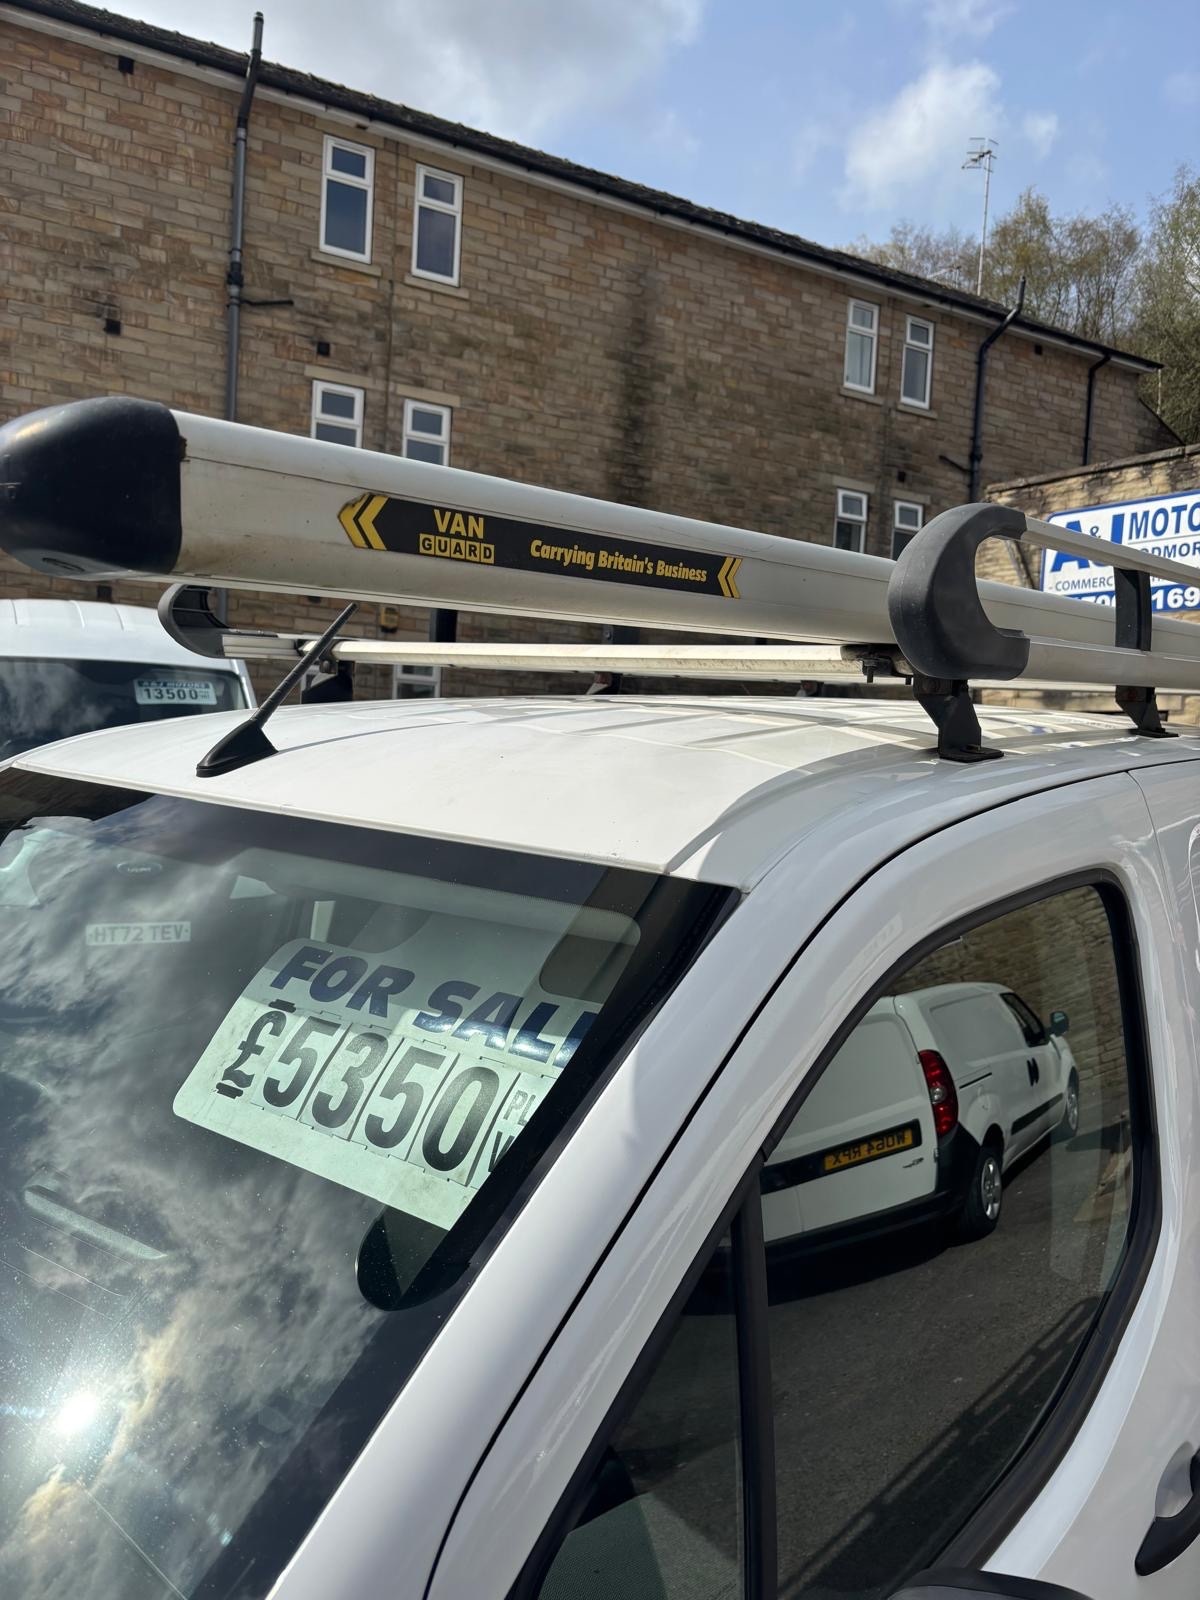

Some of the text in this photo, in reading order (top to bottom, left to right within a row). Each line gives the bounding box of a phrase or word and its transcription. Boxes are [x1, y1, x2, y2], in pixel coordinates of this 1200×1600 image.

[433, 508, 484, 539] VAN
[1128, 502, 1200, 540] MOTO
[420, 535, 494, 562] GUARD
[530, 539, 708, 583] Carrying Britain's Business
[143, 688, 199, 700] 13500
[93, 923, 184, 942] HT72 TEV
[270, 945, 415, 1018] FOR
[216, 1000, 500, 1172] £5350
